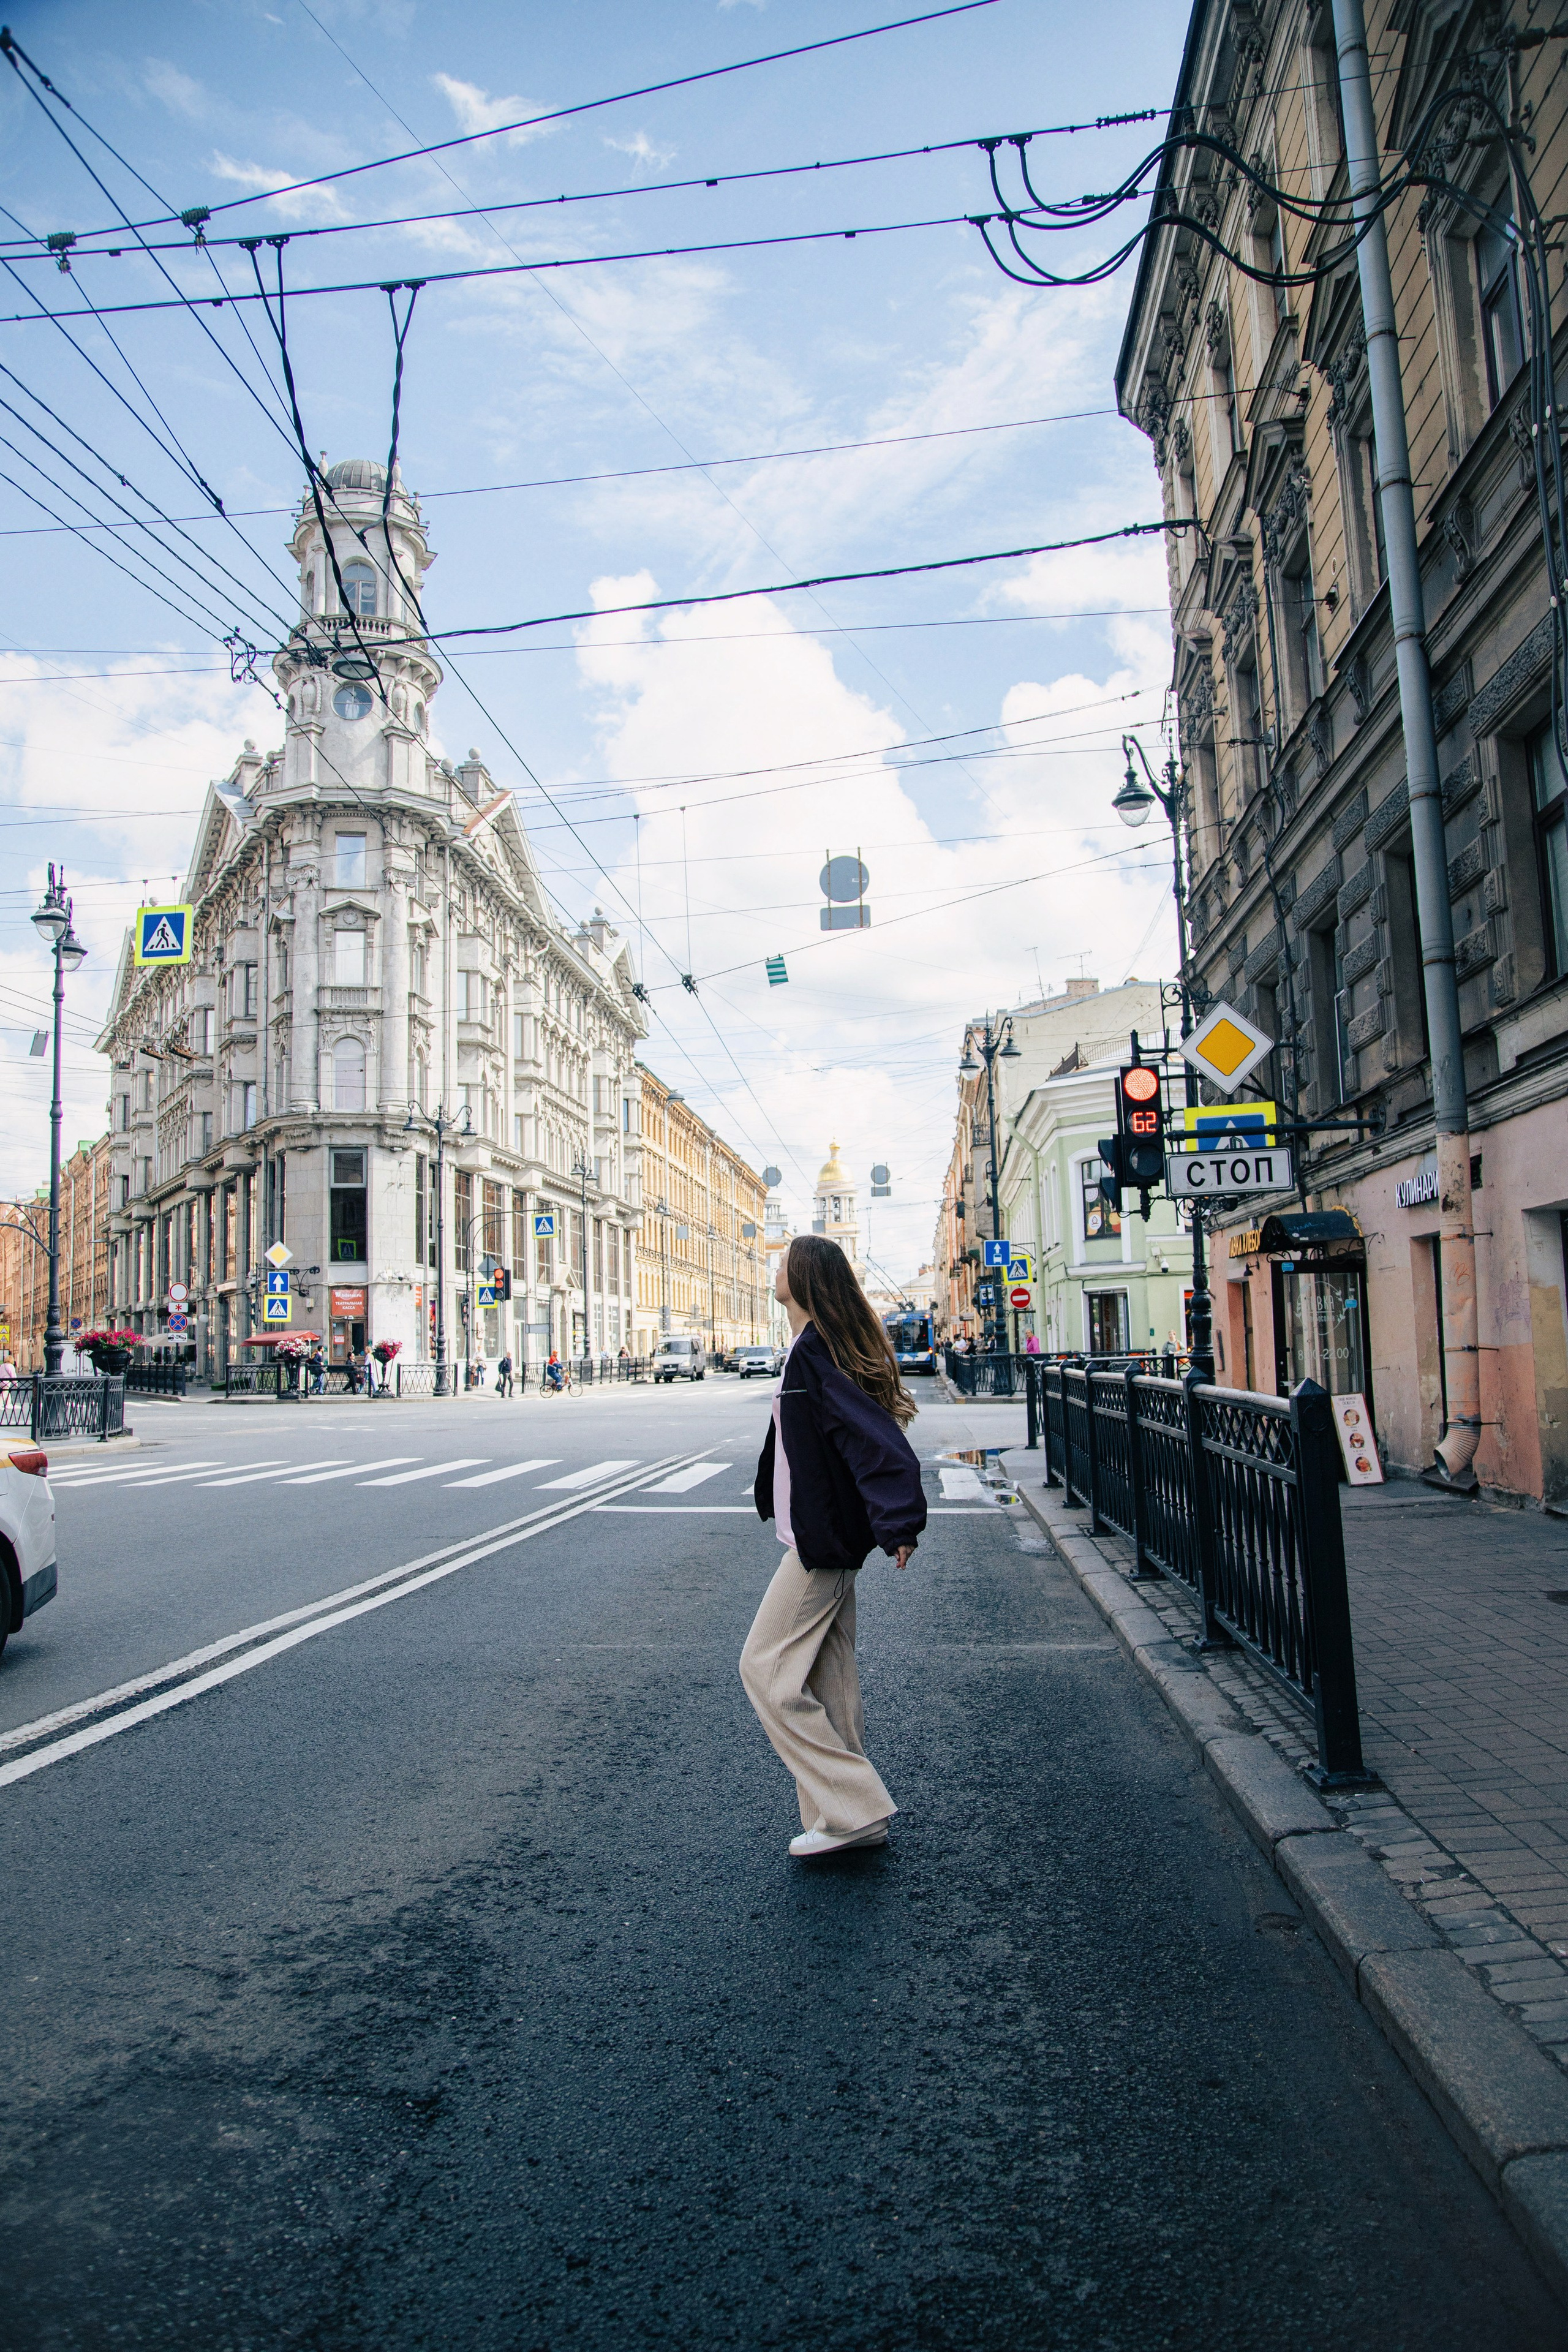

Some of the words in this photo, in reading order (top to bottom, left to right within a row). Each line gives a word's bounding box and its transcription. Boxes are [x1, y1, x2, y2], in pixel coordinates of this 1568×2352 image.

[1133, 1112, 1156, 1133] 62
[1187, 1157, 1273, 1187] СТОП
[1395, 1170, 1439, 1208] КУЛИНАРИ
[1229, 1233, 1242, 1257] ЛАВКА
